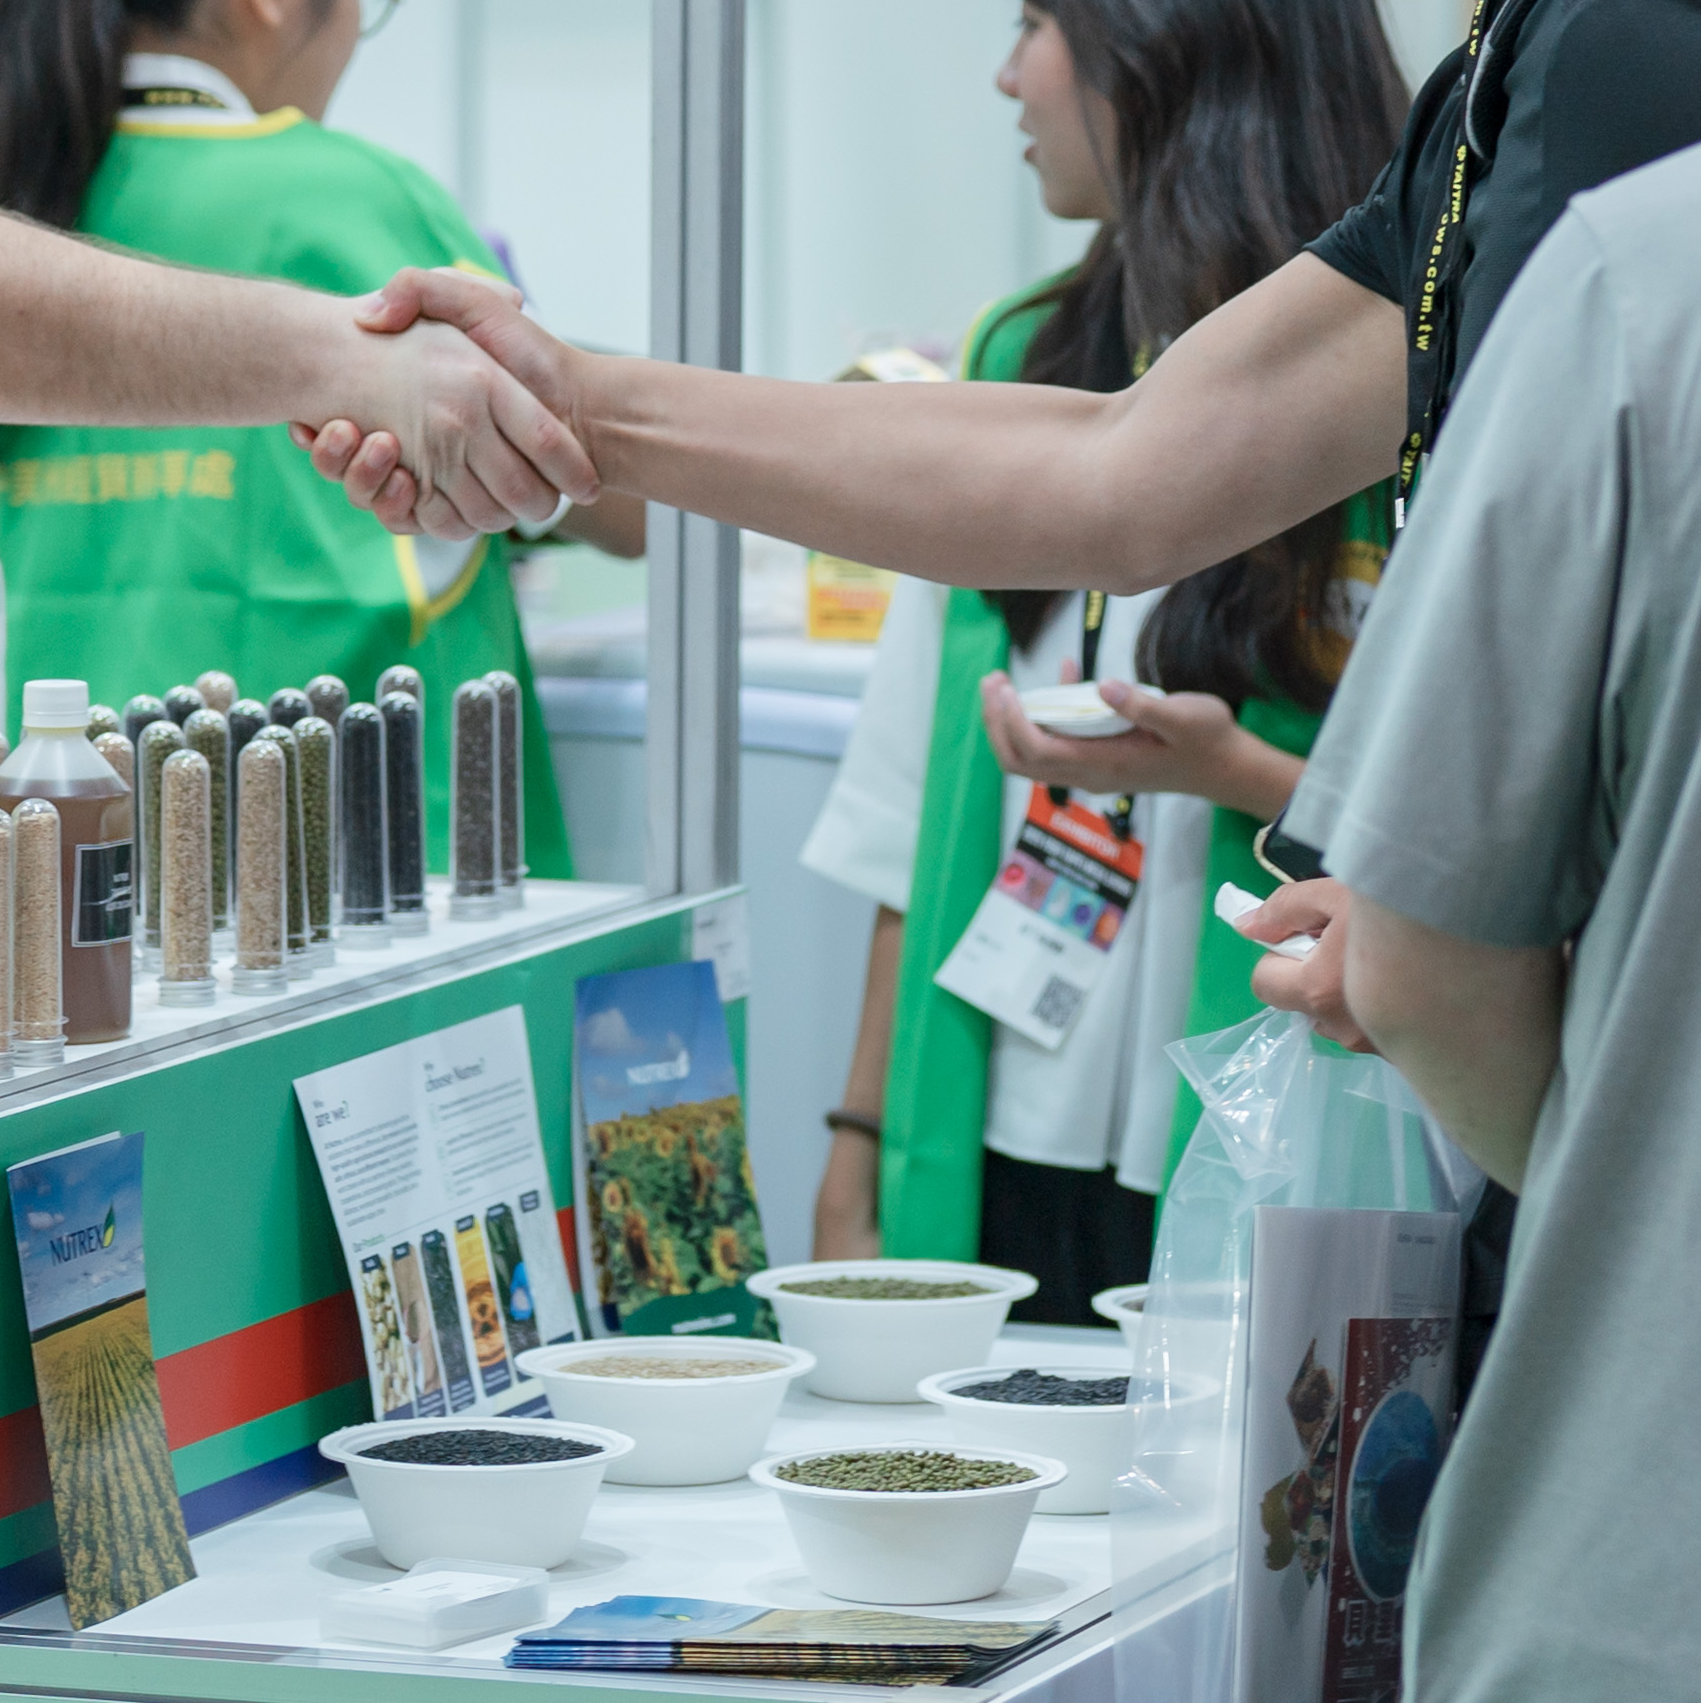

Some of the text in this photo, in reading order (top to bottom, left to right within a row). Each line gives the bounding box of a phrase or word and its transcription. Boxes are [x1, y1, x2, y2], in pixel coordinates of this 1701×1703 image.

[1450, 161, 1466, 224] TAITRA
[1415, 211, 1449, 352] ows.com.tw
[49, 1222, 105, 1267] NUTREX
